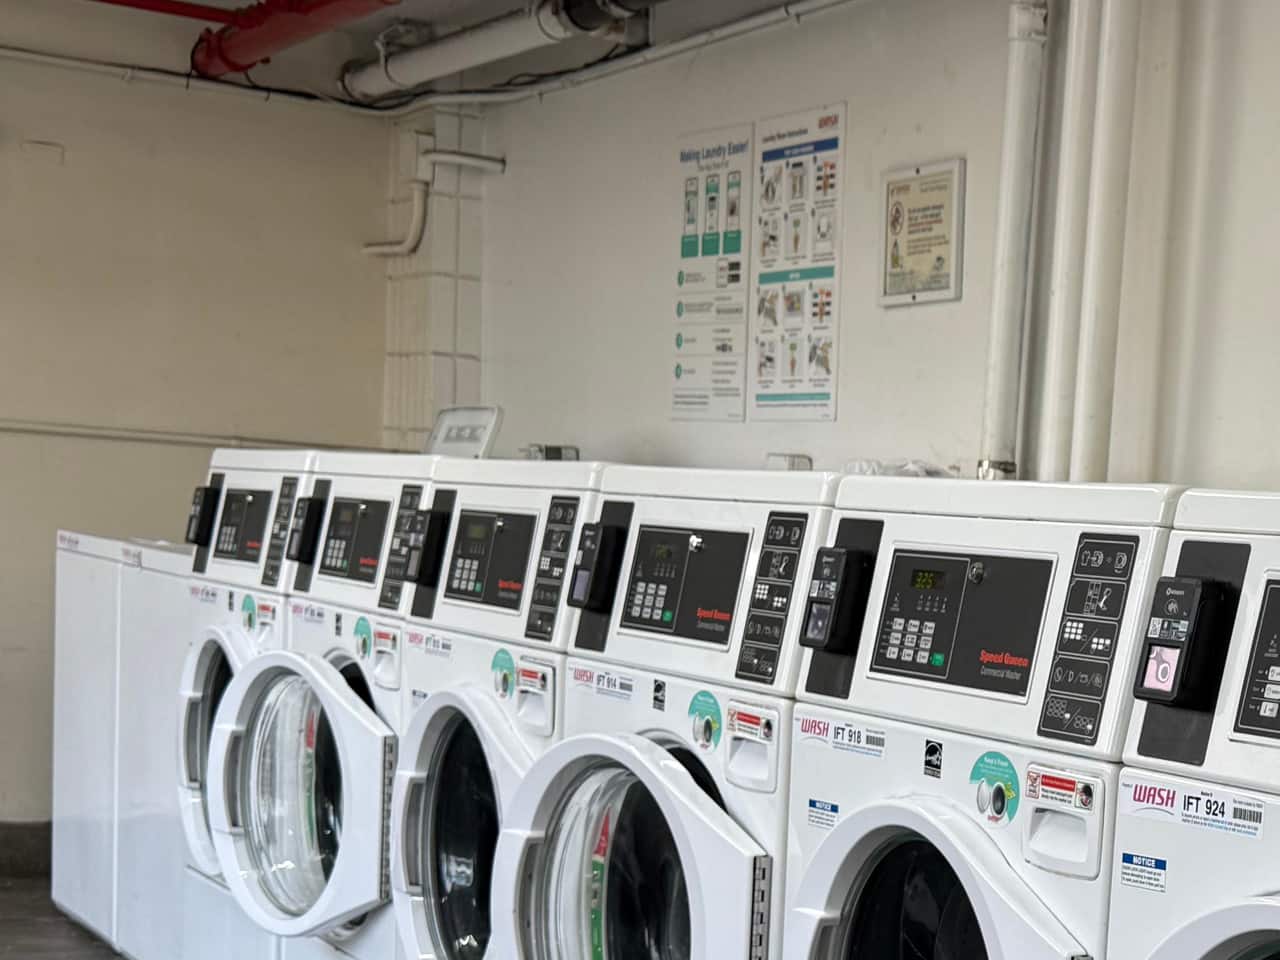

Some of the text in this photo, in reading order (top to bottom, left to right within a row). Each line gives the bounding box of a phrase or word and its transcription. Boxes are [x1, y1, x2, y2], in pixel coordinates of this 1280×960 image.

[800, 718, 830, 737] WASH
[833, 726, 862, 744] IFT 918
[1132, 784, 1176, 808] WASH
[1183, 794, 1202, 814] IFT
[1205, 799, 1226, 818] 924
[1132, 856, 1156, 868] NOTICE
